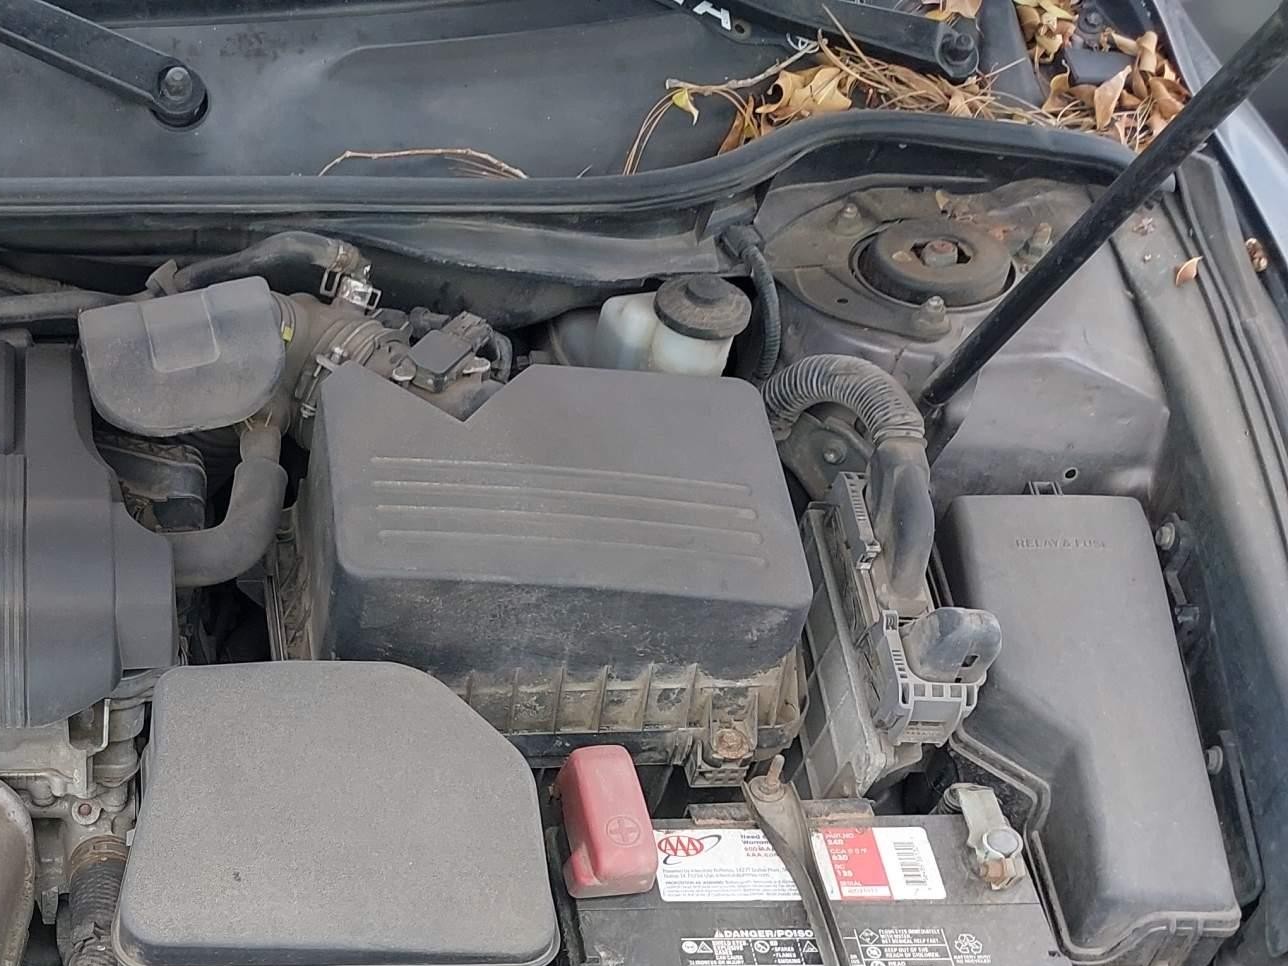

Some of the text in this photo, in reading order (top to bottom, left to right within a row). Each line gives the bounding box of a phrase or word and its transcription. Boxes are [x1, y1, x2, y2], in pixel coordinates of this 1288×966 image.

[1015, 538, 1058, 549] RELAY
[663, 835, 700, 857] AAA
[724, 929, 814, 938] DANGER/POISO
